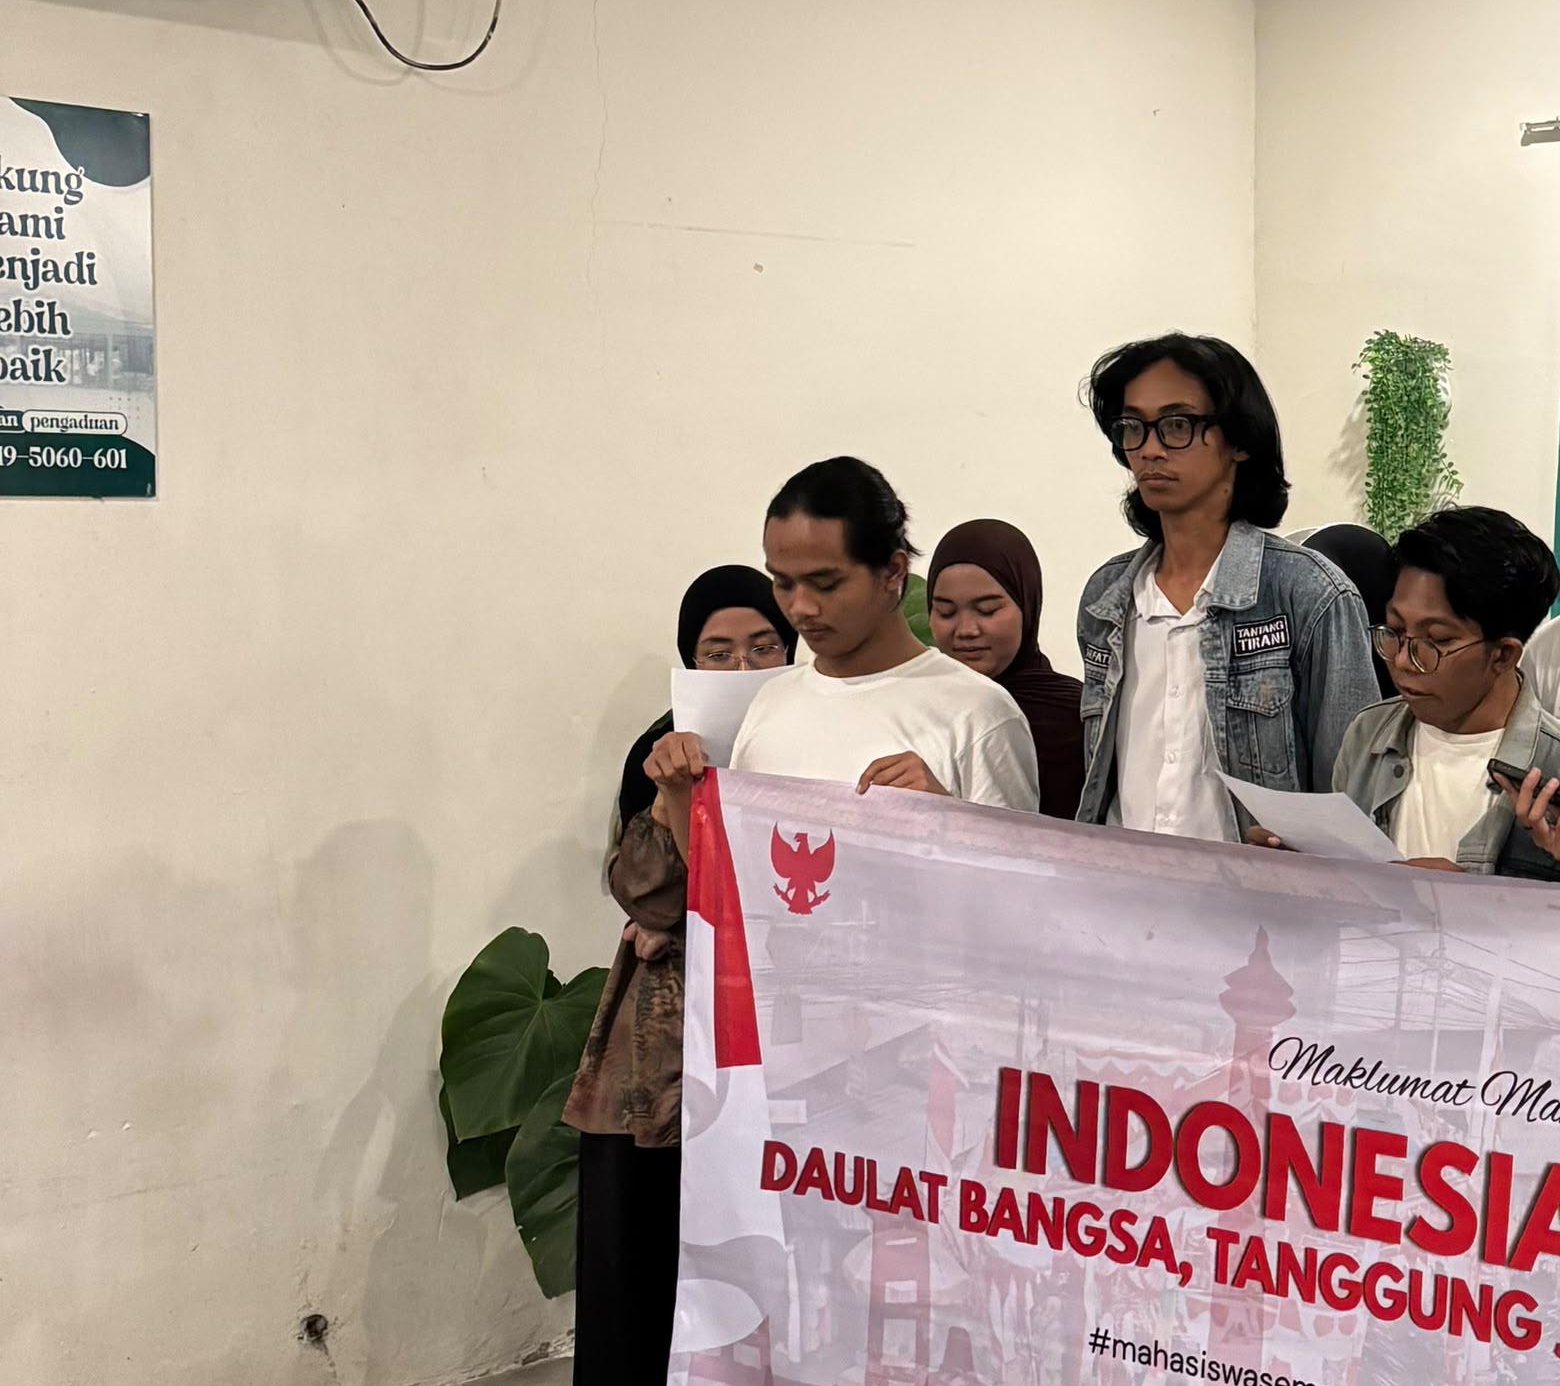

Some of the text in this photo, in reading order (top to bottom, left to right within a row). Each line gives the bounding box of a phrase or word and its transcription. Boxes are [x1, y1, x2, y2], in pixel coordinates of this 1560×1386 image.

[30, 414, 119, 432] pengaduan
[1236, 620, 1285, 638] TANTANG
[1238, 631, 1286, 652] TIRANI
[1268, 1036, 1475, 1107] Maklumat
[760, 1140, 948, 1224] DAULAT
[959, 1178, 1194, 1288] BANGSA,
[1206, 1226, 1543, 1353] TANGGUNG
